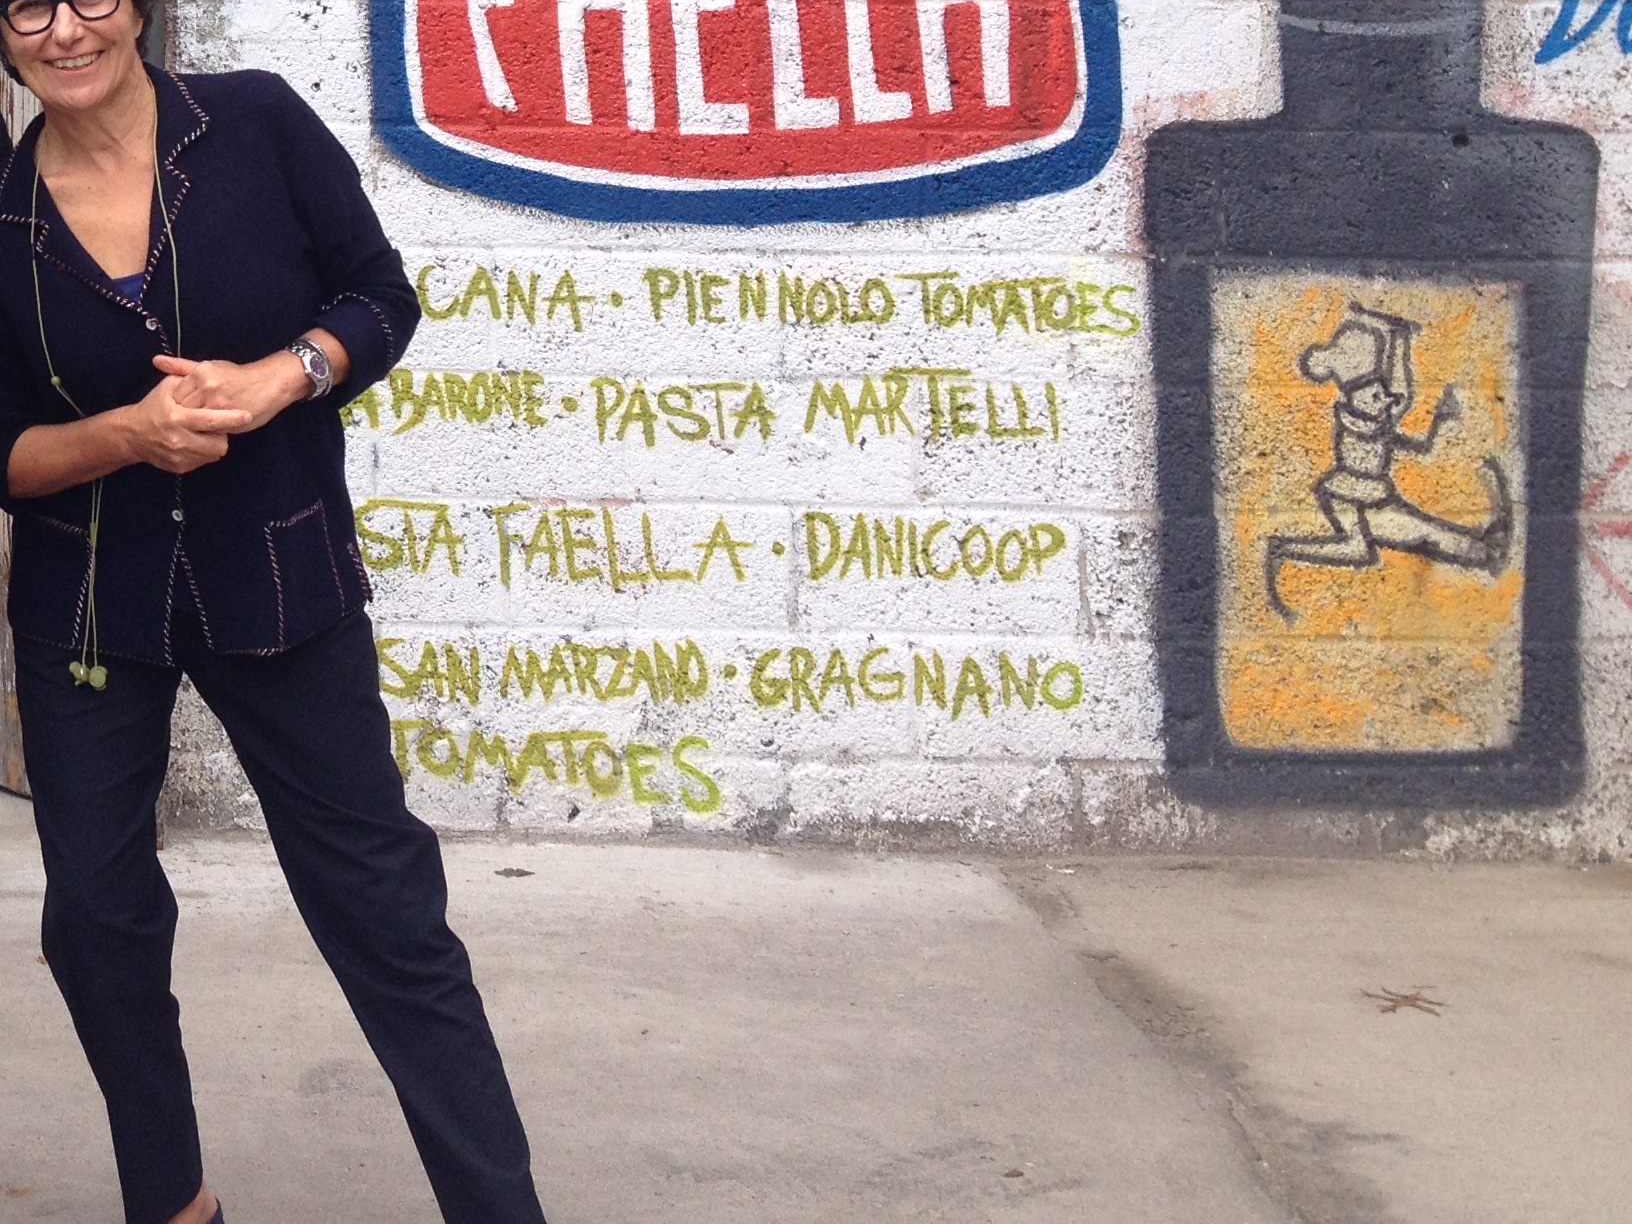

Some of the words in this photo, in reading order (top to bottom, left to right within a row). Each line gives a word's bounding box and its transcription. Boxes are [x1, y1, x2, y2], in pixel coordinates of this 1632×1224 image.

[894, 271, 1142, 337] TOMATOES
[589, 377, 776, 447] PASTA
[803, 367, 1061, 444] MARTELLI
[491, 501, 755, 594] FAELLA
[802, 511, 1068, 584] DANICOOP
[375, 637, 482, 707] SAN
[499, 636, 710, 706] MARZANO
[749, 644, 1084, 721] GRAGNANO
[390, 719, 722, 815] TOMATOES
